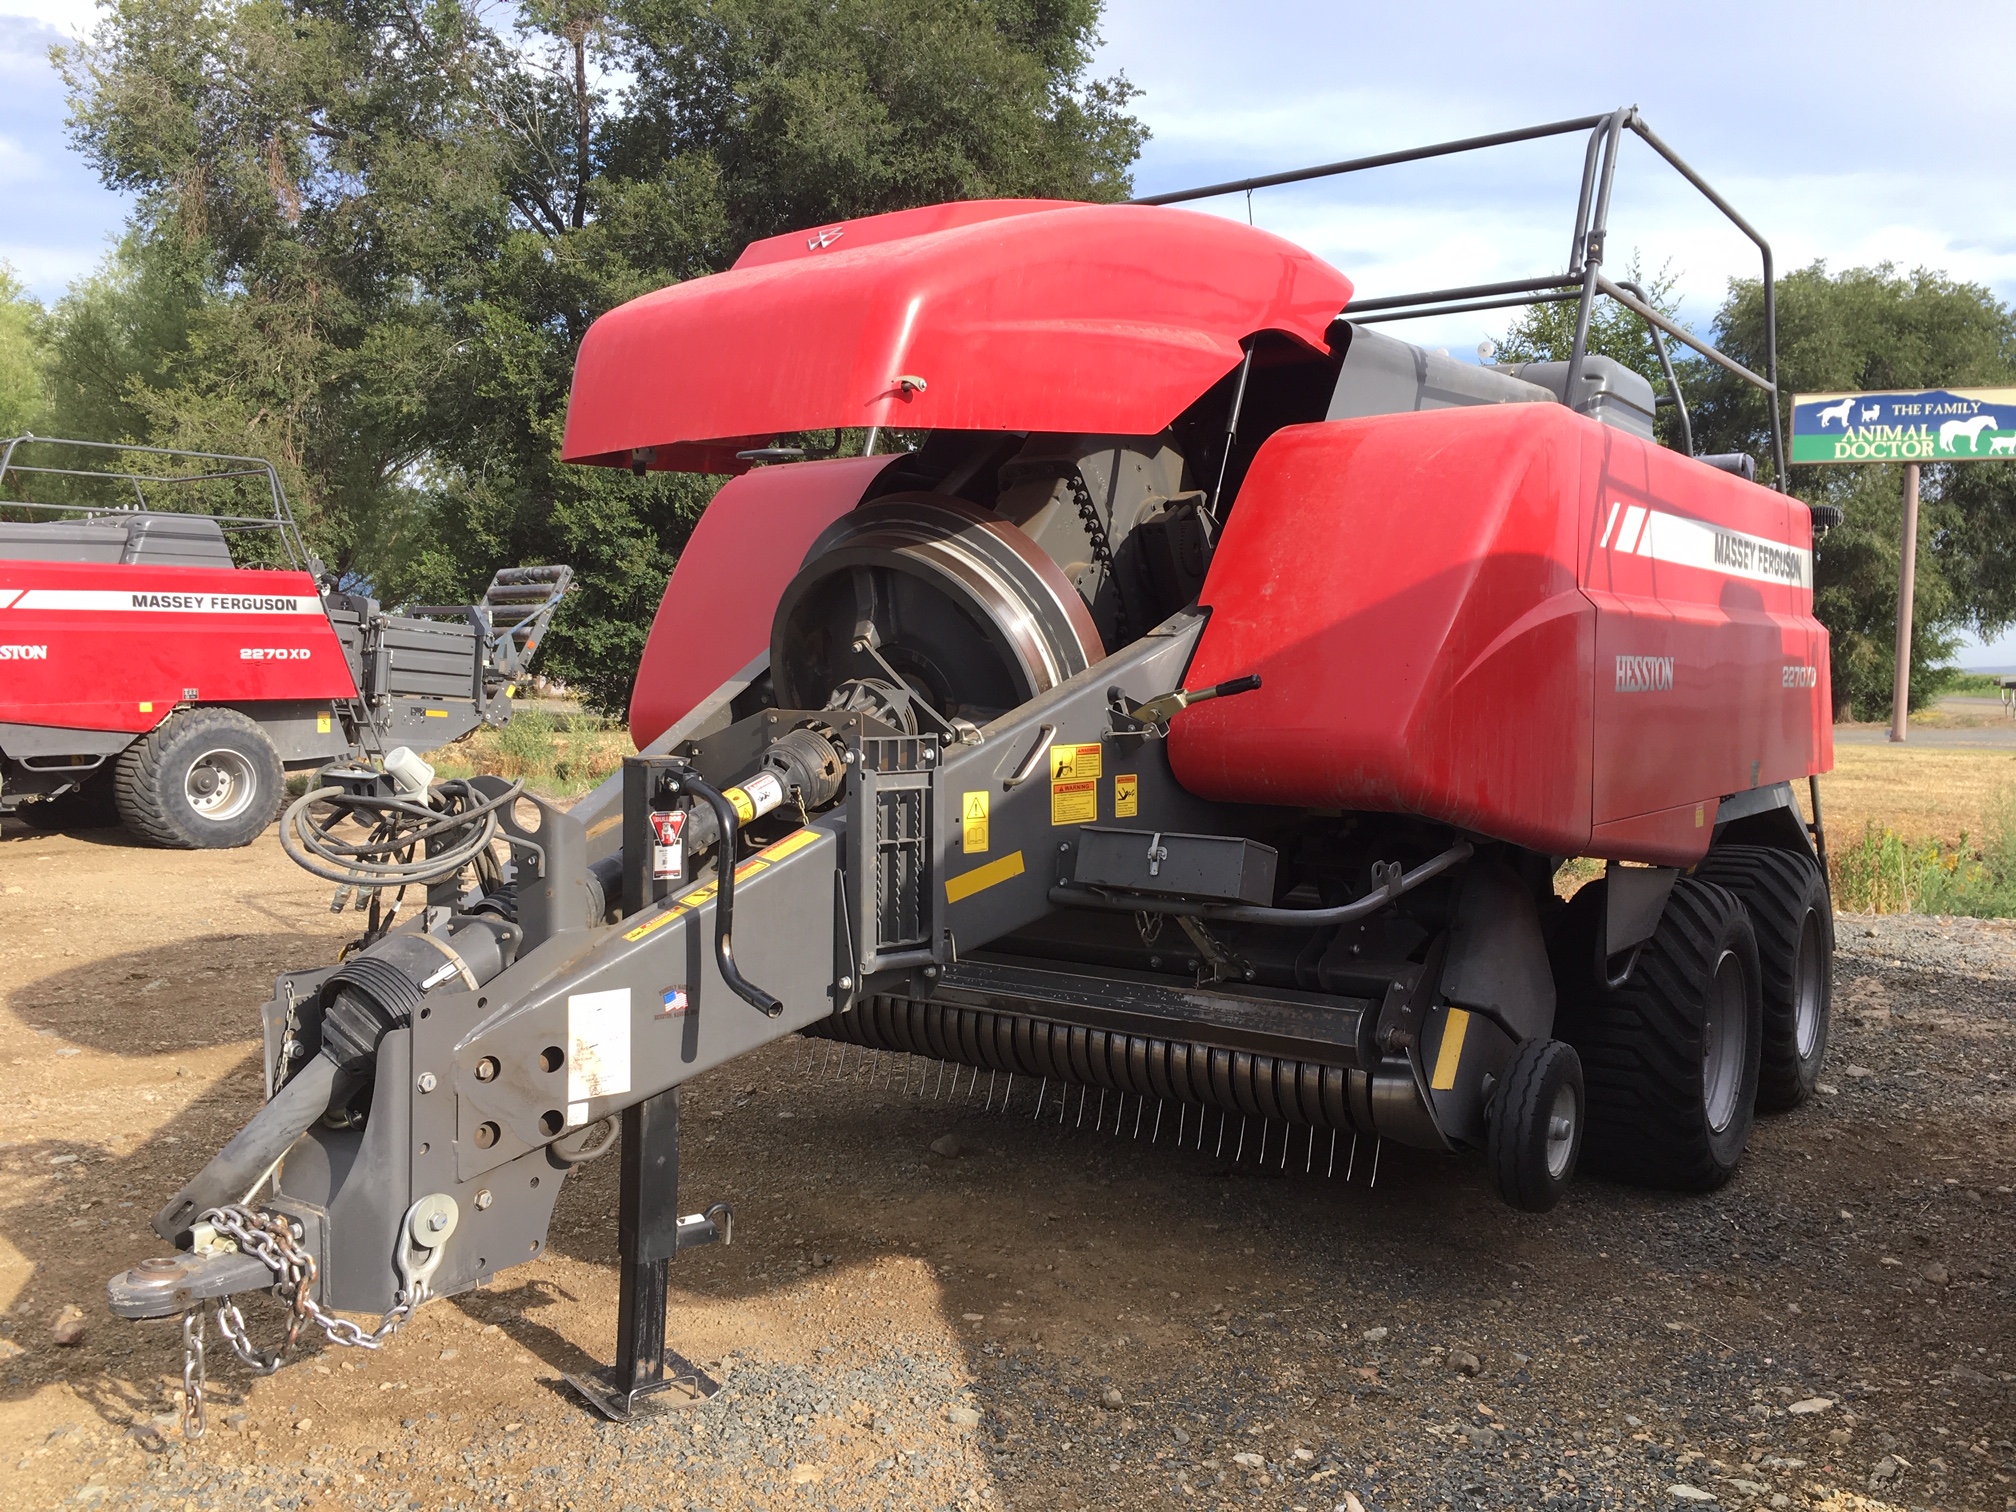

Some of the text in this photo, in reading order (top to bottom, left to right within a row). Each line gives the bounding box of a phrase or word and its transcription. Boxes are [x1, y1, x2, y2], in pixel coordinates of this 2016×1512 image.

[1892, 402, 1981, 416] THE FAMILY
[1841, 424, 1934, 442] ANIMAL
[1834, 440, 1935, 459] DOCTOR
[1714, 532, 1802, 580] MASSEY FERGUSON
[132, 594, 297, 611] MASSEY FERGUSON
[1615, 655, 1674, 692] HESSTON
[1782, 665, 1817, 688] 2270XD
[1064, 783, 1090, 792] WARNING
